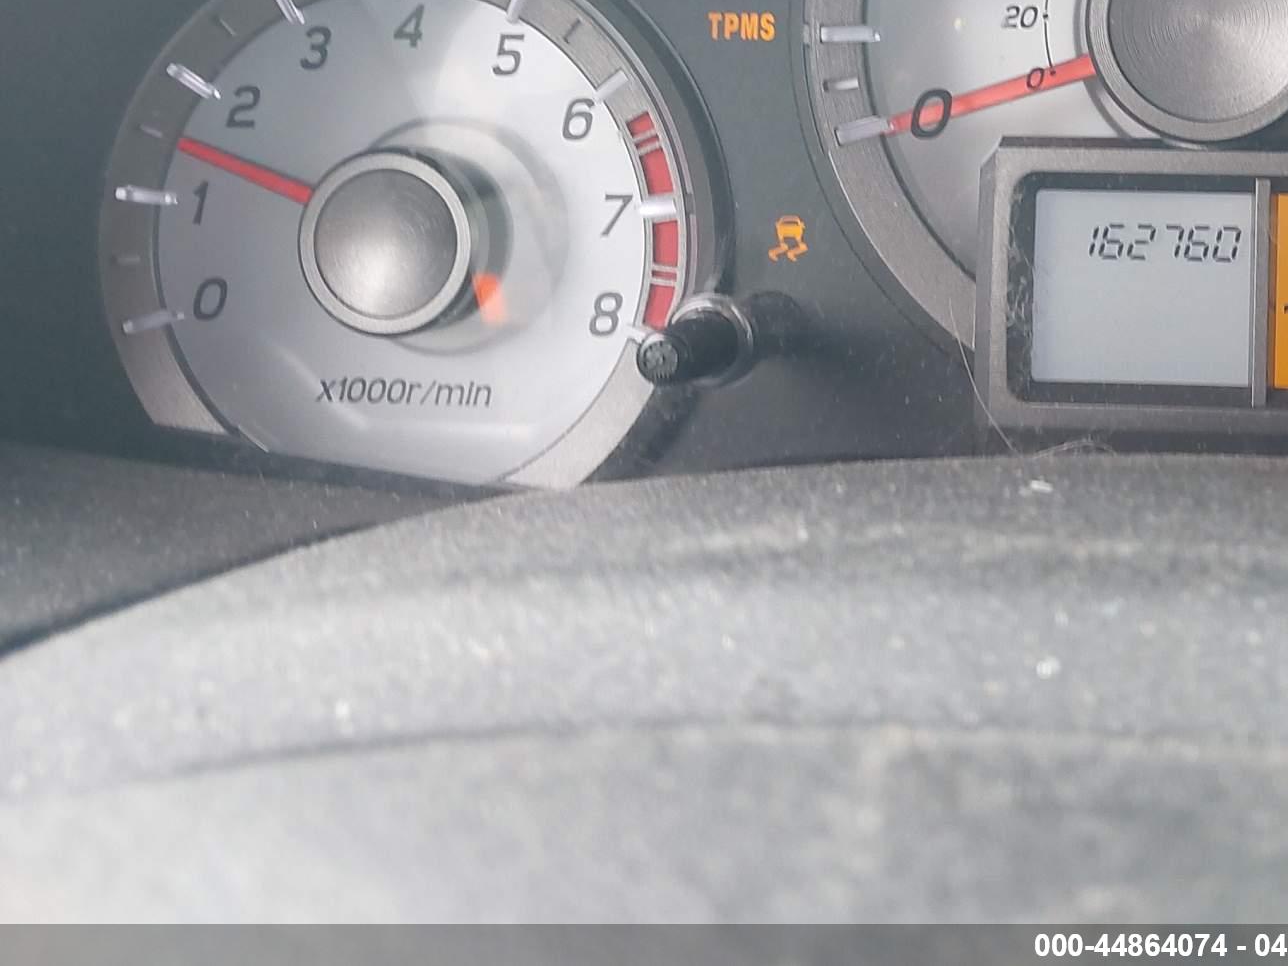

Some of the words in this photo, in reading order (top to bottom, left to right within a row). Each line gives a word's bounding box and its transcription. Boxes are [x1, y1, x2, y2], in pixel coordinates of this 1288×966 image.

[393, 4, 426, 49] 4
[707, 11, 776, 42] TPMS
[1003, 5, 1039, 29] 20
[301, 26, 332, 70] 3
[493, 34, 525, 76] 5
[1026, 67, 1045, 91] 0
[226, 85, 261, 129] 2
[562, 97, 595, 141] 6
[911, 88, 953, 139] 0
[192, 181, 210, 225] 1
[602, 193, 633, 237] 7
[1088, 223, 1242, 263] 162760
[194, 277, 227, 321] 0
[590, 292, 622, 336] 8
[316, 375, 493, 409] x1000r/min
